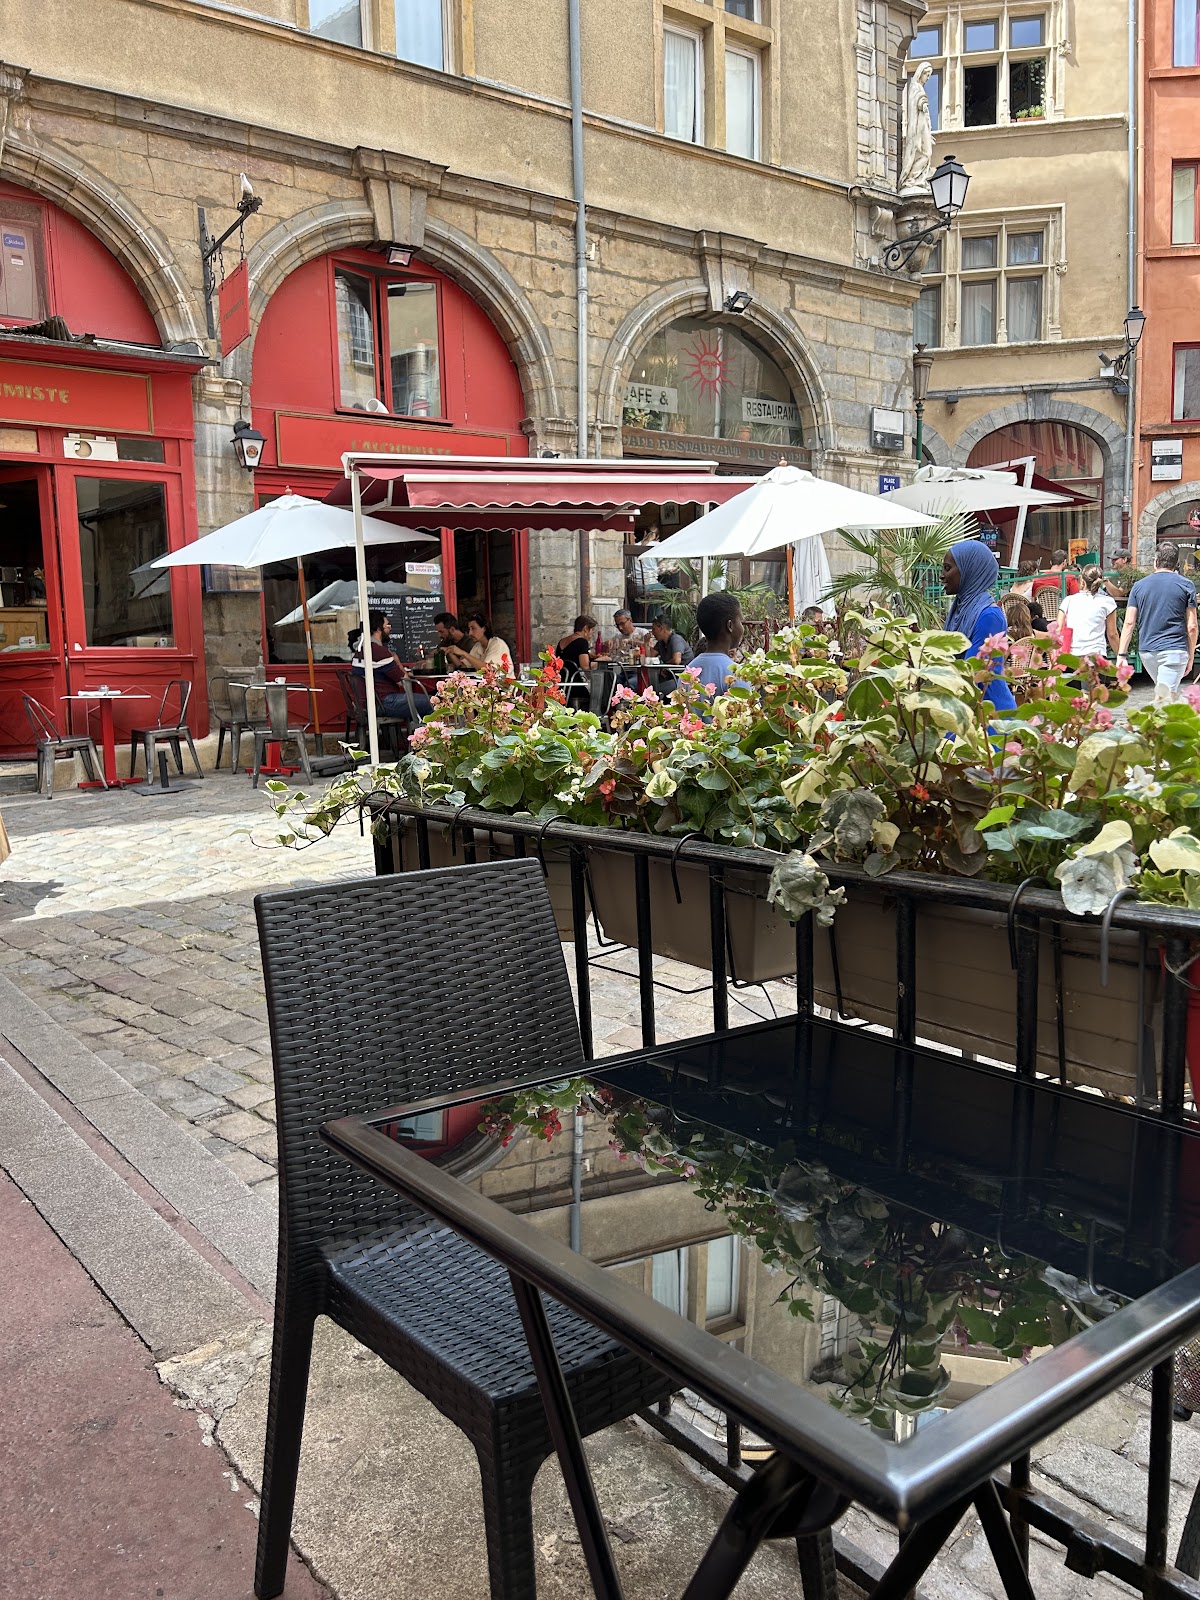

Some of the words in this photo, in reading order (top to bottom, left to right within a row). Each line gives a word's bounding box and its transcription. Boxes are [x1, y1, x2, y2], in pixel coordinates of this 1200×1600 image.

[0, 383, 70, 403] MISTE
[660, 391, 669, 405] &
[748, 448, 766, 460] DU
